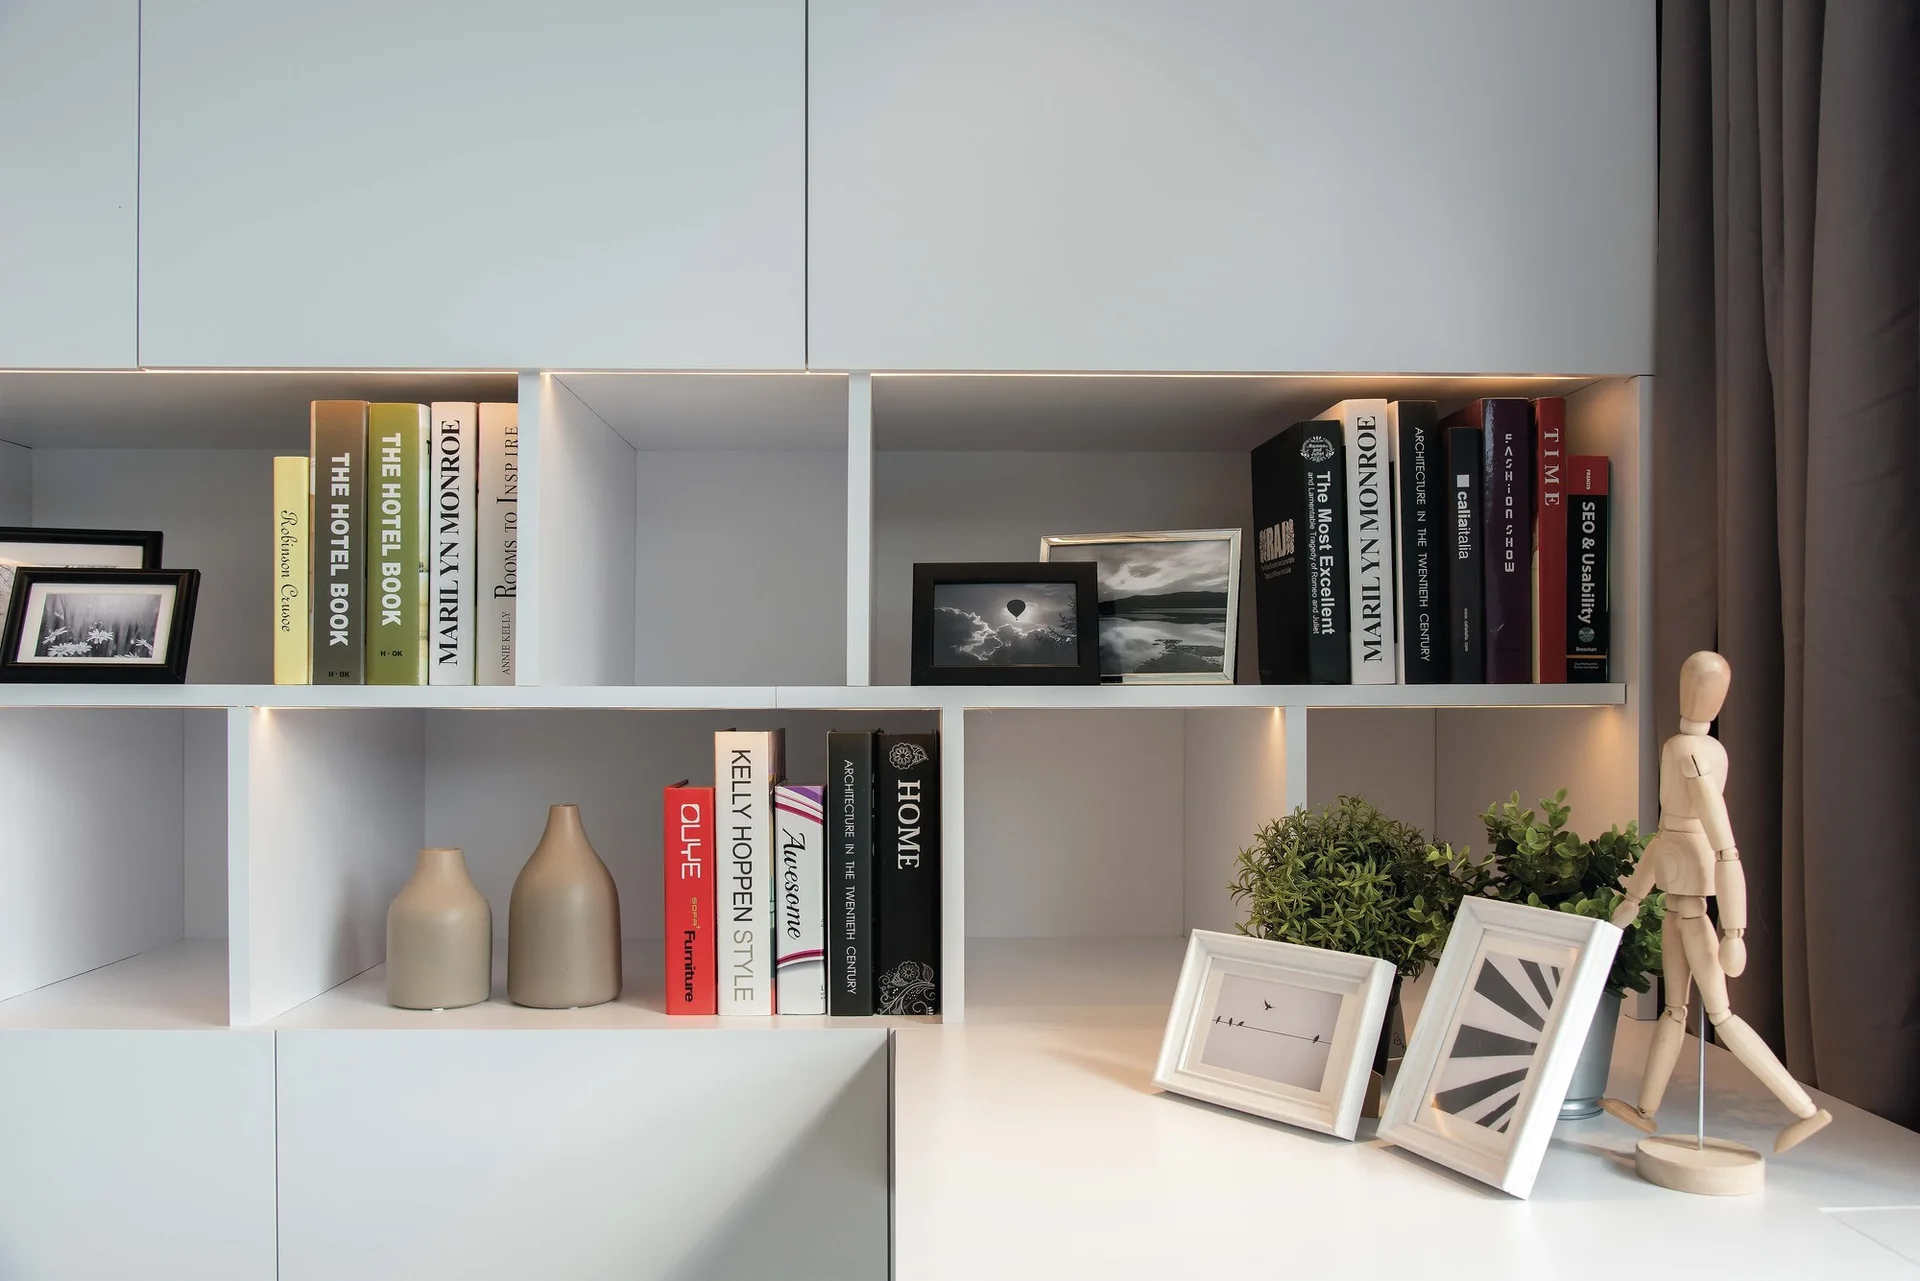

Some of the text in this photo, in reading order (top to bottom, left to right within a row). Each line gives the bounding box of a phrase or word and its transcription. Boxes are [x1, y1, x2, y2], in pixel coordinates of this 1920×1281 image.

[1307, 472, 1315, 486] and
[1307, 487, 1317, 530] Lamentable
[1544, 428, 1560, 507] TIME
[280, 510, 299, 632] Robinson Crusoe
[329, 453, 350, 647] THE HOTEL BOOK
[381, 433, 402, 627] THE HOTEL BOOK
[438, 419, 461, 666] MARILYN MONROE
[1308, 532, 1317, 562] Tragedy
[1310, 562, 1318, 571] of
[1316, 470, 1336, 635] The Most Excellent
[1356, 415, 1383, 663] MARILYN MONROE
[1414, 427, 1431, 662] ARCHITECTURE IN THE TWENTIETH CENTURY
[1457, 490, 1472, 560] caliaitalia
[1577, 501, 1596, 625] SEO & Usability
[1311, 572, 1319, 598] Romeo
[1312, 600, 1320, 613] and
[501, 611, 512, 675] ANNIE KELLY
[731, 749, 754, 1002] KELLY HOPPEN STYLE
[897, 779, 921, 870] HOME
[782, 827, 806, 940] Awesome
[843, 759, 857, 995] ARCHITECTURE IN THE TWENTIETH CENTURY
[683, 930, 696, 1003] Furniture
